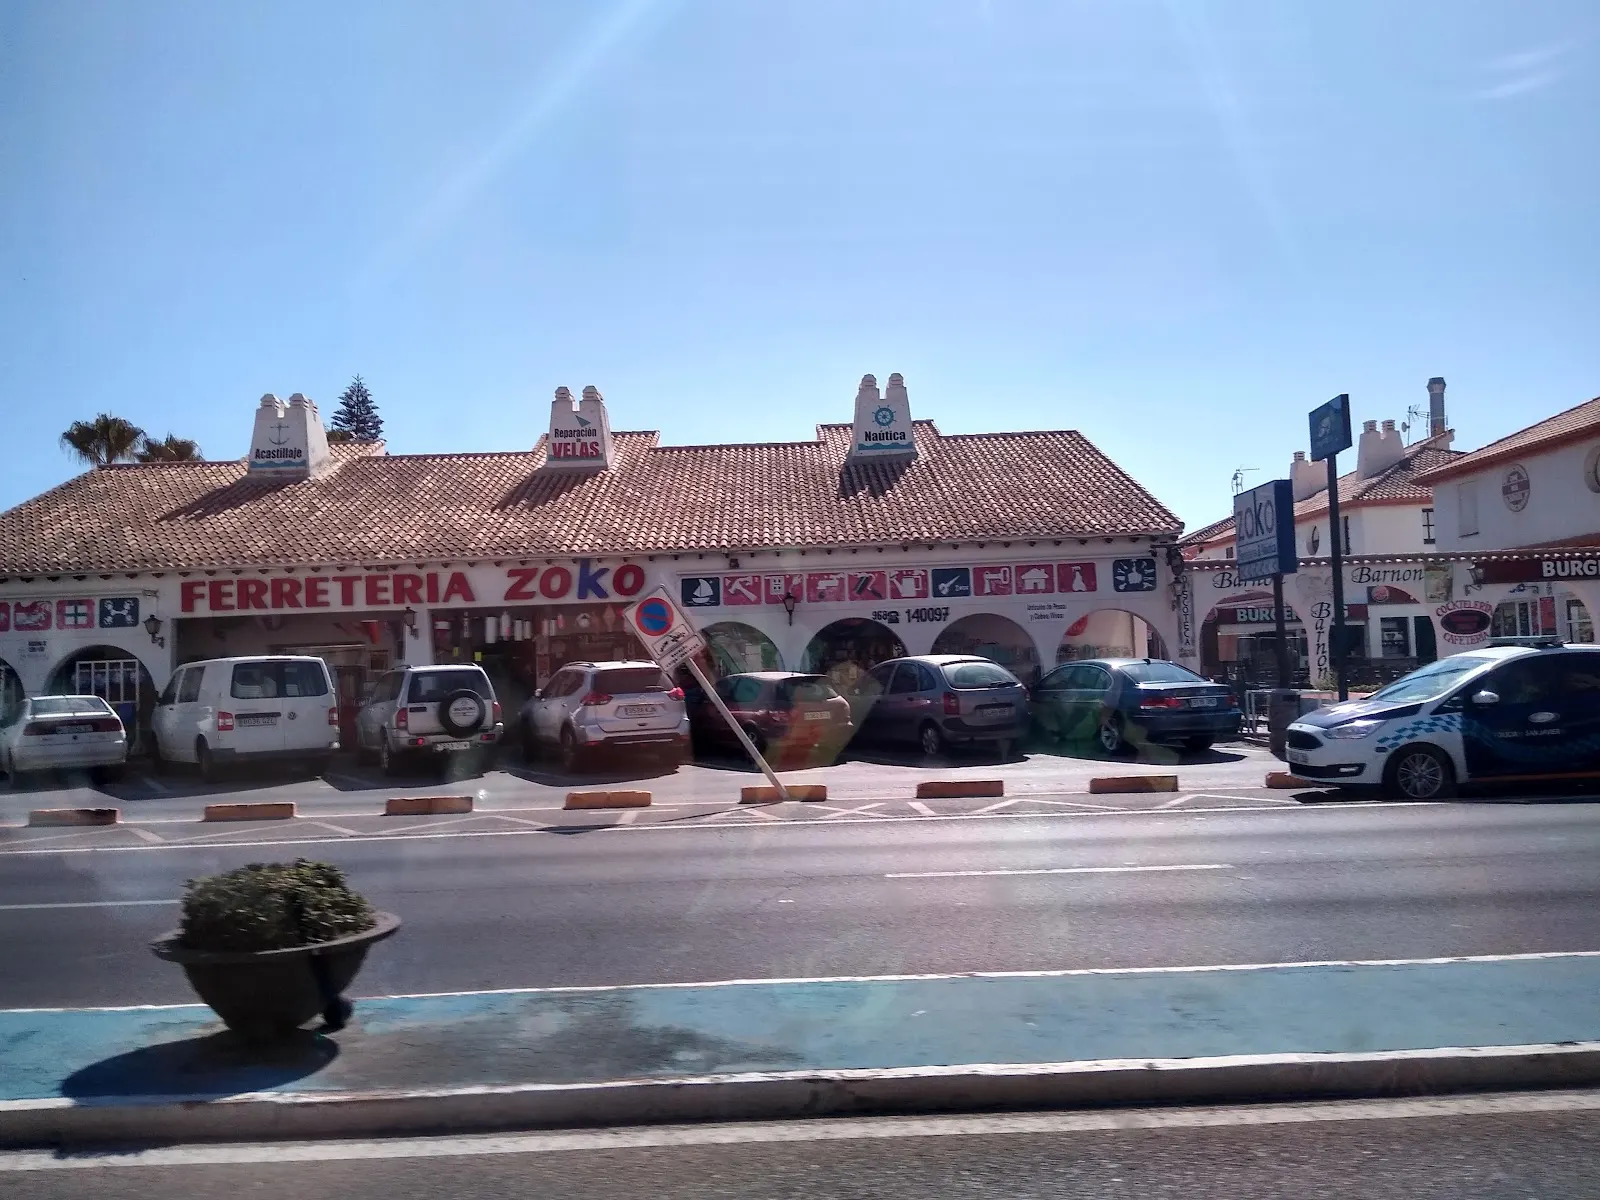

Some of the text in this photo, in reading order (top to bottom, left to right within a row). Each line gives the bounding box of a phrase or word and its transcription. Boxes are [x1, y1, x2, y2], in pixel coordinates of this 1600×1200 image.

[554, 427, 597, 439] Reparación
[864, 429, 906, 442] Naútica
[255, 447, 303, 460] Acastillaje
[552, 441, 600, 458] VELAS
[1351, 566, 1425, 583] Barnon
[1542, 559, 1600, 577] BURG
[1212, 572, 1288, 588] Barno
[181, 571, 476, 613] FERRETERIA
[872, 606, 951, 624] 968 140097
[1181, 575, 1190, 646] DISCOTECA
